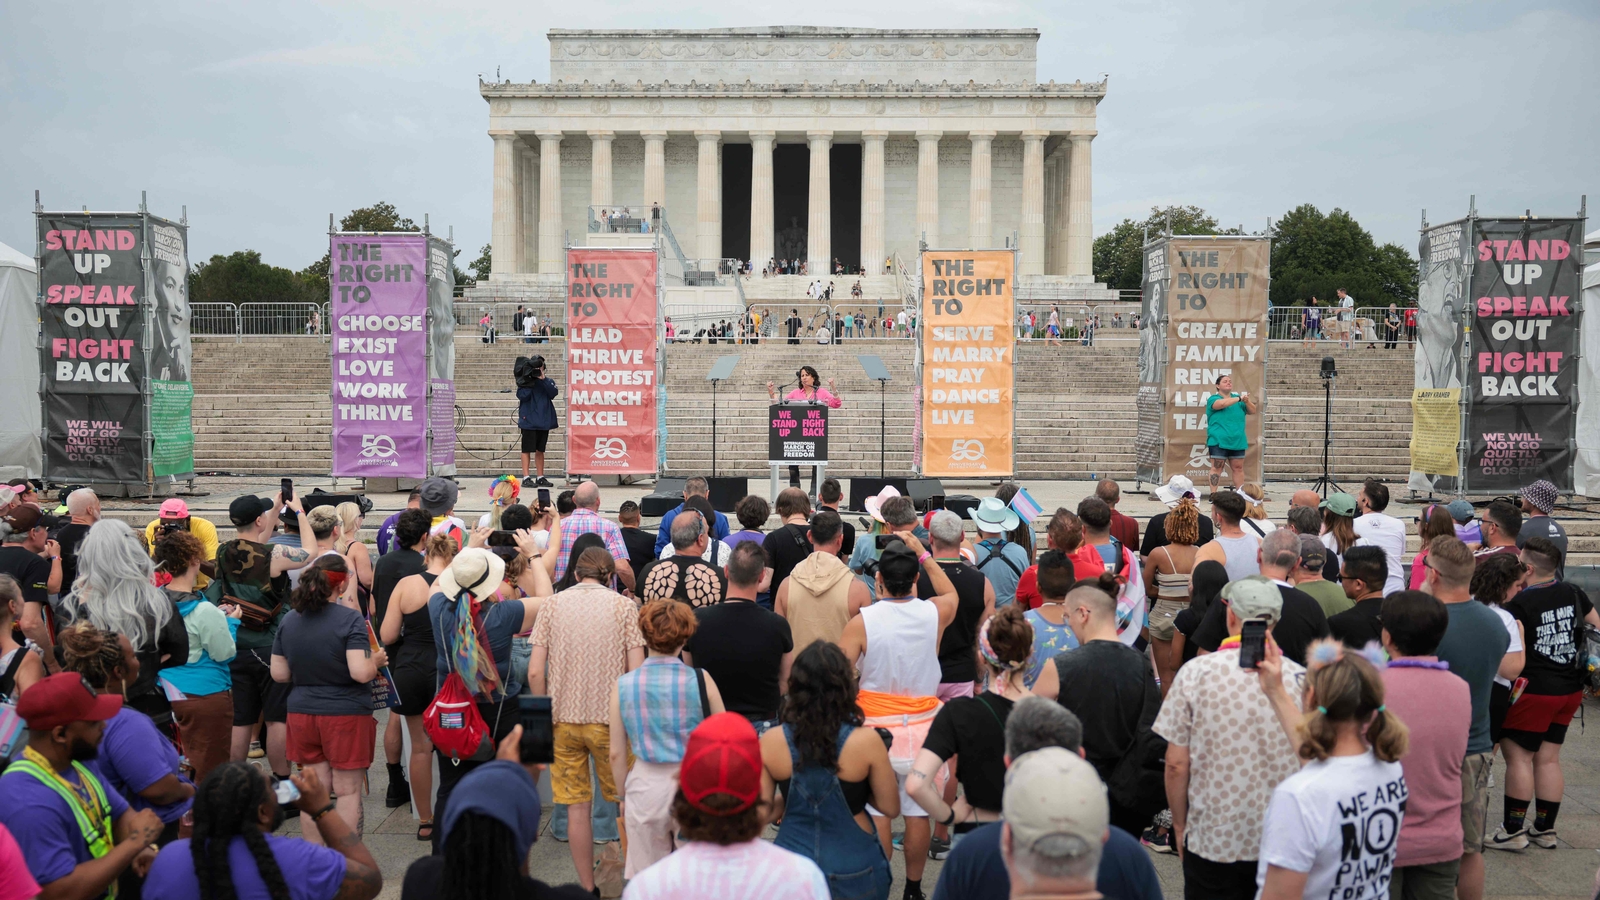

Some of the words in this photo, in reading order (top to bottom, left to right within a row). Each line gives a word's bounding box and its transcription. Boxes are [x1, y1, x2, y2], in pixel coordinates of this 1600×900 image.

[46, 230, 135, 250] STAND
[1430, 234, 1450, 246] MARCH
[1450, 230, 1461, 242] ON
[337, 243, 382, 262] THE
[1431, 247, 1461, 263] FREEDOM
[1478, 240, 1570, 261] STAND
[74, 254, 111, 274] UP
[1179, 251, 1218, 267] THE
[340, 264, 414, 282] RIGHT
[571, 264, 607, 278] THE
[932, 260, 974, 276] THE
[1503, 264, 1542, 285] UP
[933, 279, 1005, 296] RIGHT
[1178, 273, 1248, 289] RIGHT
[46, 285, 135, 305] SPEAK
[338, 286, 371, 303] TO
[572, 283, 634, 298] RIGHT
[571, 302, 597, 317] TO
[932, 299, 963, 315] TO
[1177, 294, 1206, 310] TO
[1477, 296, 1570, 317] SPEAK
[64, 307, 120, 327] OUT
[338, 315, 422, 332] CHOOSE
[571, 328, 623, 343] LEAD
[933, 326, 994, 341] SERVE
[1177, 323, 1257, 338] CREATE
[1492, 319, 1551, 340] OUT
[52, 338, 134, 359] FIGHT
[338, 338, 397, 354] EXIST
[1176, 345, 1260, 361] FAMILY
[571, 350, 643, 364] THRIVE
[932, 348, 1007, 362] MARRY
[1478, 352, 1563, 373] FIGHT
[56, 362, 130, 382] BACK
[339, 360, 394, 376] LOVE
[932, 368, 985, 382] PRAY
[572, 371, 653, 385] PROTEST
[1481, 376, 1559, 396] BACK
[338, 382, 407, 399] WORK
[571, 391, 642, 406] MARCH
[932, 389, 999, 403] DANCE
[1174, 392, 1247, 406] LEA
[338, 404, 413, 421] THRIVE
[572, 411, 628, 426] EXCEL
[807, 410, 820, 418] WE
[932, 410, 974, 424] LIVE
[66, 420, 88, 428] WE
[91, 421, 123, 429] WILL
[772, 420, 797, 428] STAND
[803, 419, 825, 428] FIGHT
[1173, 414, 1208, 430] TEA
[779, 429, 790, 437] UP
[803, 428, 824, 436] BACK
[1482, 433, 1505, 441] WE
[1508, 433, 1542, 441] WILL
[65, 445, 96, 453] INTO
[67, 437, 120, 445] QUIETLY
[362, 434, 396, 457] 50
[595, 437, 626, 458] 50
[952, 439, 984, 461] 50
[1484, 450, 1541, 458] QUIETLY
[1480, 458, 1513, 466] INTO
[1541, 610, 1555, 624] THE
[1536, 624, 1556, 637] THEY
[1558, 619, 1571, 631] TRY
[1537, 632, 1569, 645] SILENCE
[1534, 644, 1551, 655] THE
[1338, 793, 1368, 818] WE
[1374, 778, 1408, 805] ARE
[1335, 853, 1395, 885] PAWN
[1329, 886, 1365, 900] FOR
